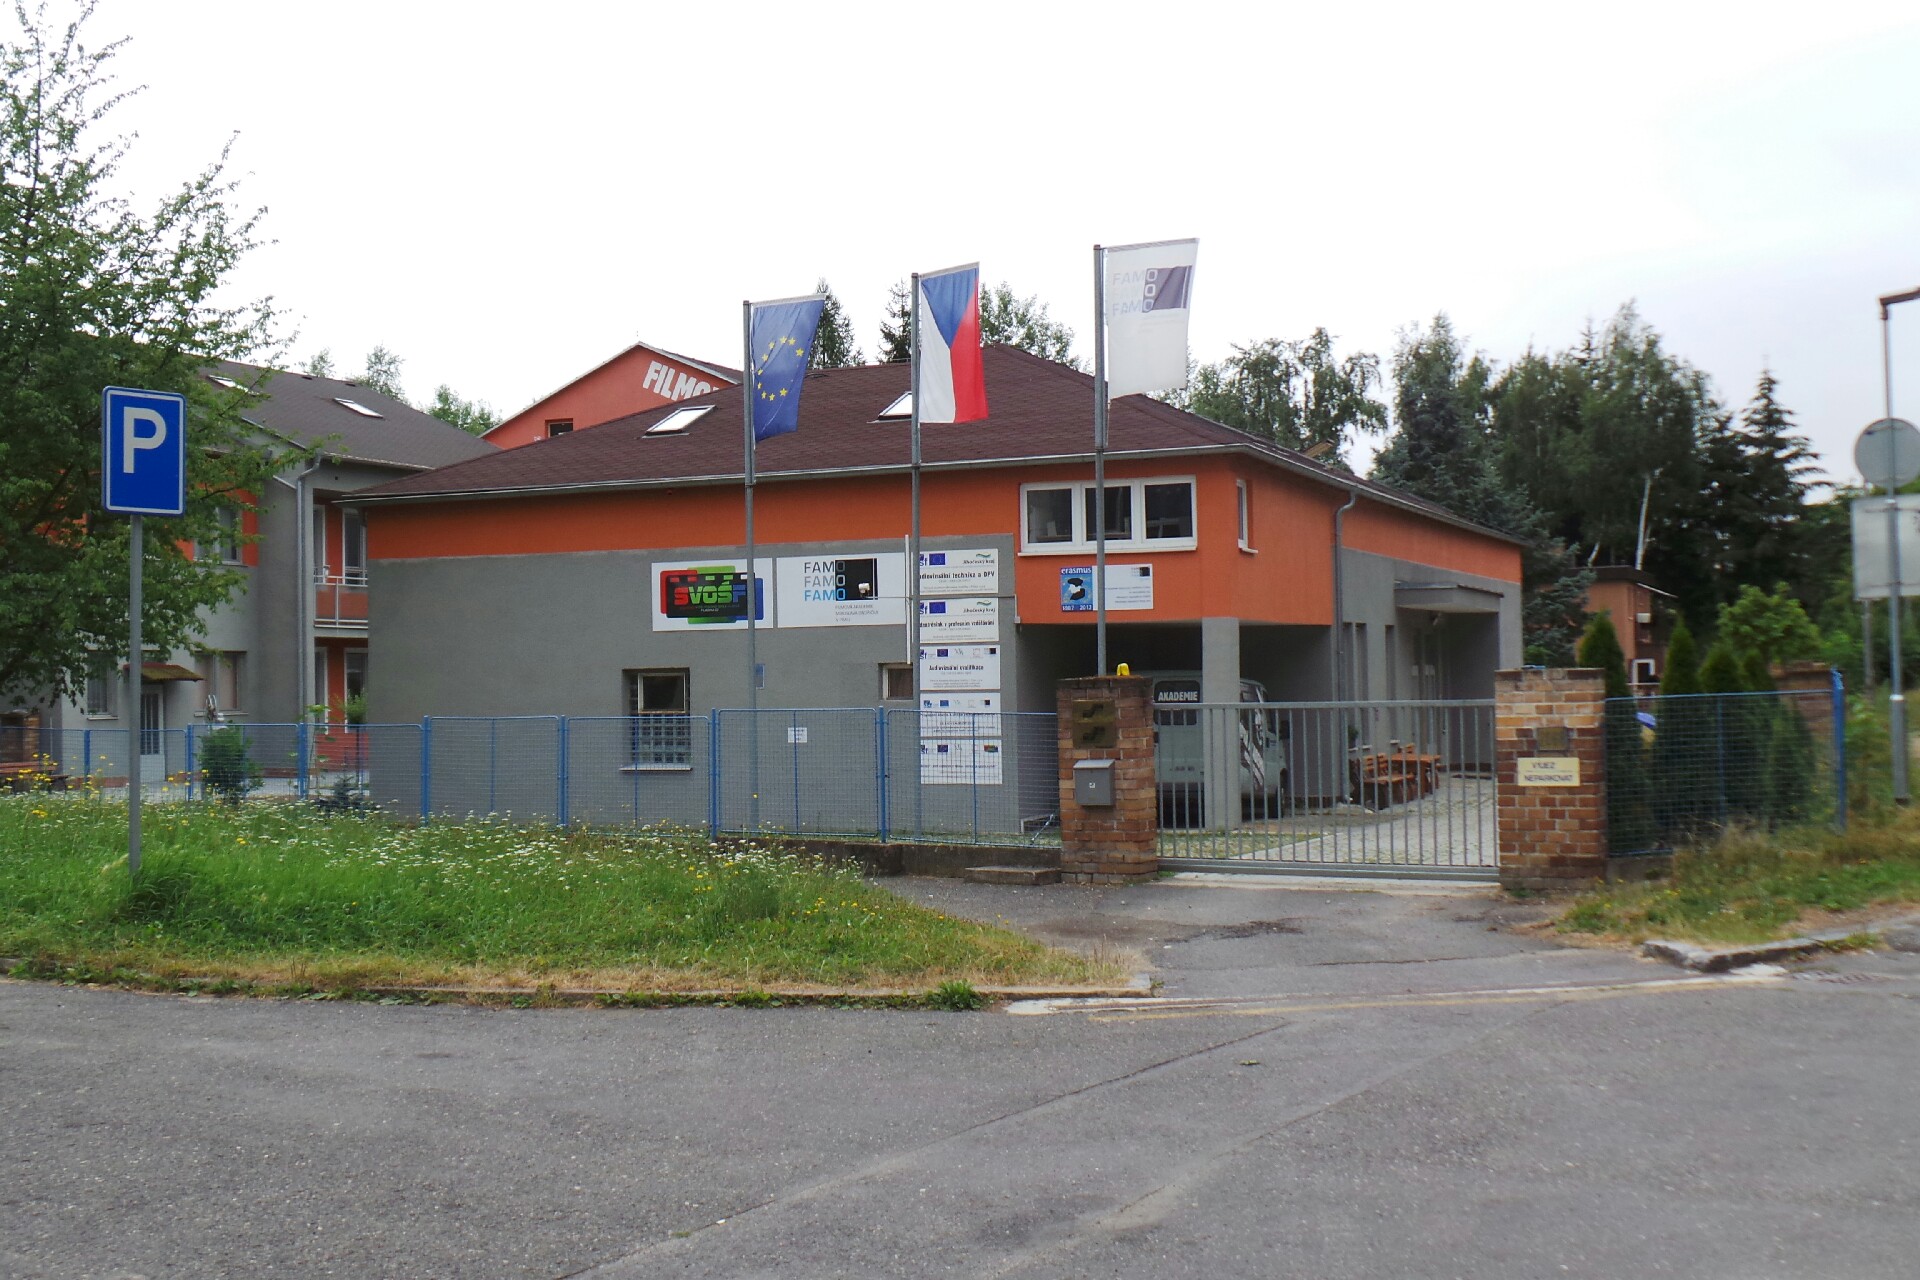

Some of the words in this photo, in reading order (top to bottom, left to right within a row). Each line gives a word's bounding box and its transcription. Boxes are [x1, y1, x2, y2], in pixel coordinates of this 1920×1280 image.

[123, 406, 167, 474] P
[804, 560, 846, 574] FAMO
[1061, 567, 1092, 575] erasmus
[804, 574, 846, 588] FAMO
[804, 588, 846, 602] FAMO
[1158, 691, 1198, 702] AKADEMIE
